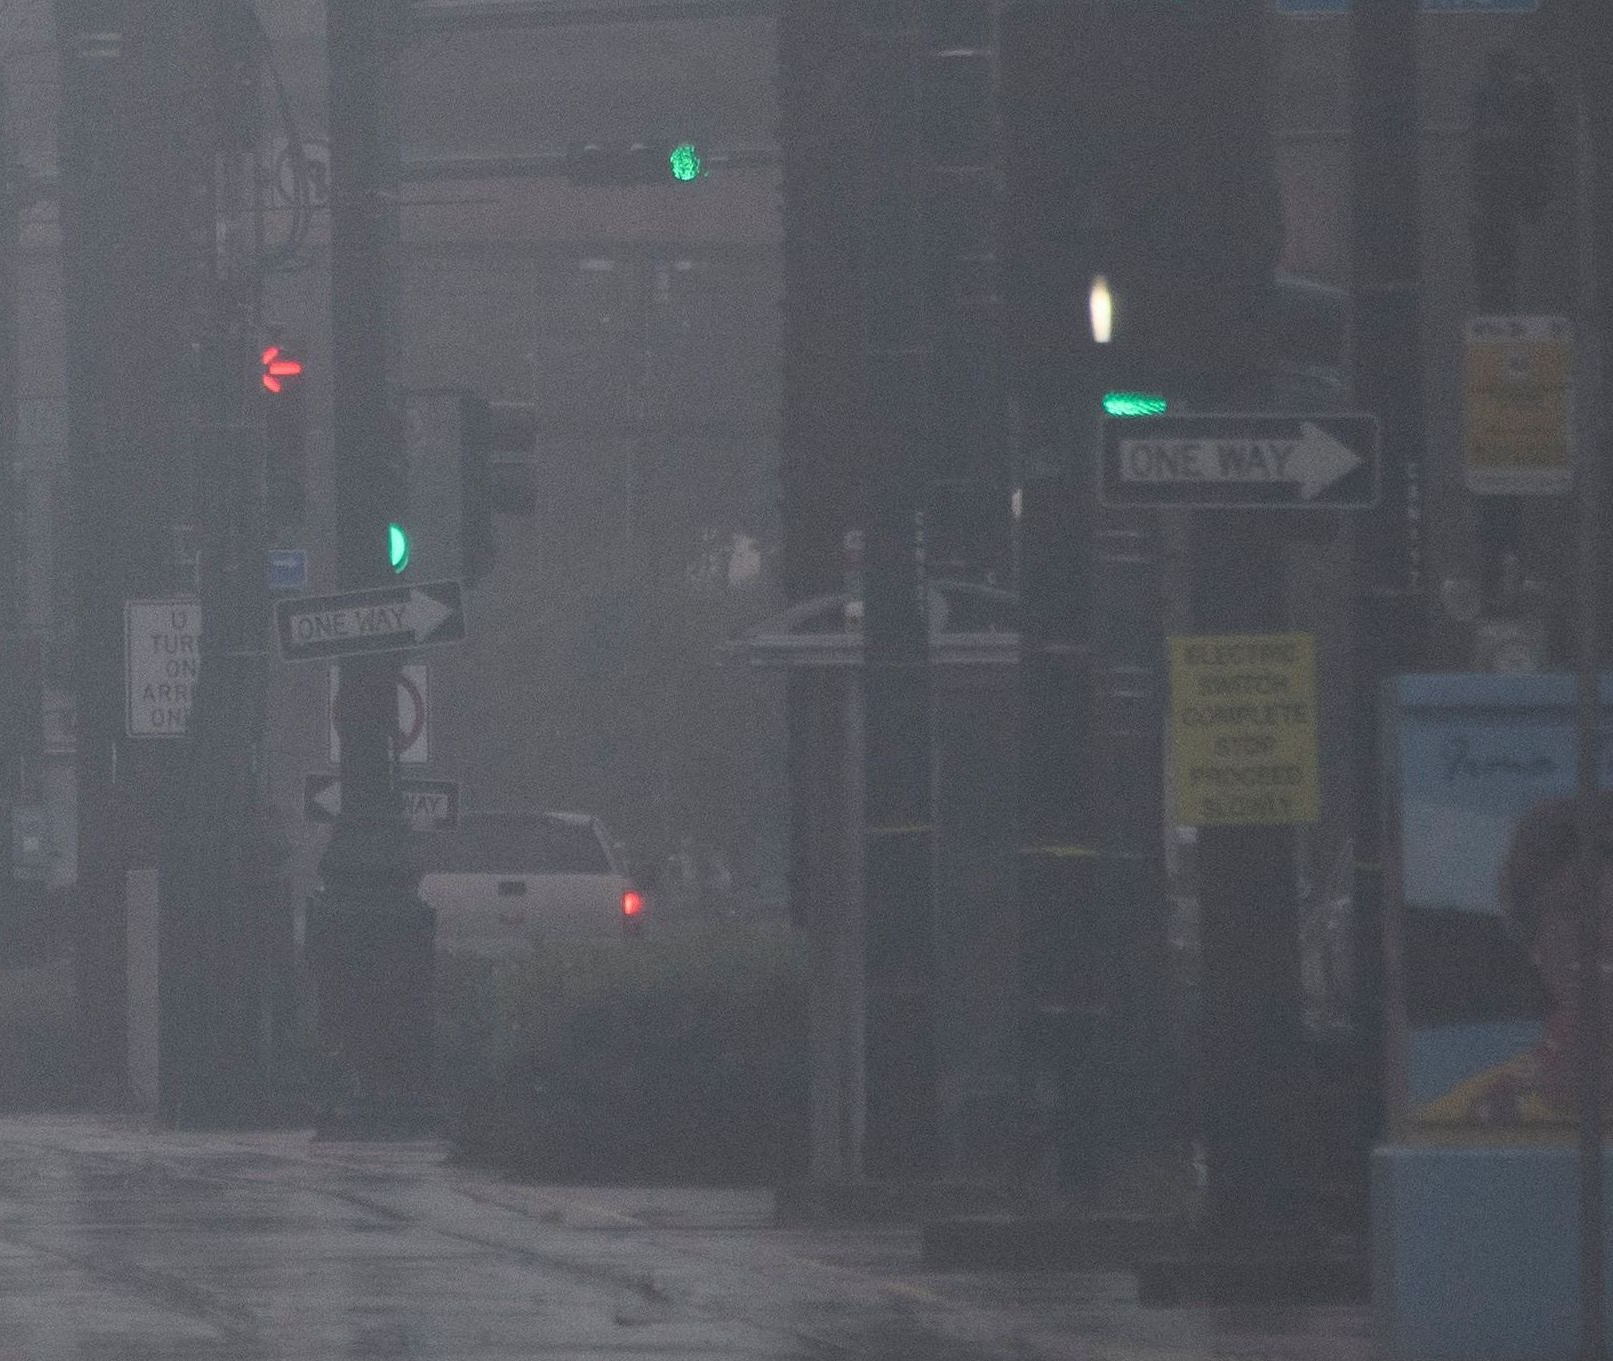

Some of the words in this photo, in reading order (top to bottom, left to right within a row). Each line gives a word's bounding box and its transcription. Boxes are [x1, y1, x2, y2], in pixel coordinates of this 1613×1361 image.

[1130, 444, 1203, 478] ONE
[1215, 443, 1294, 479] WAY
[298, 612, 347, 640] ONE
[355, 604, 408, 633] WAY
[150, 634, 194, 654] TUR
[1185, 644, 1296, 665] ELECTRIC
[165, 659, 196, 678] ON
[142, 683, 189, 703] ARR
[1199, 673, 1290, 695] SWITCH
[1181, 703, 1307, 726] COMPLETE
[1214, 736, 1276, 756] STOP
[1189, 765, 1303, 786] PROCEED
[1201, 796, 1292, 817] SLOWLY
